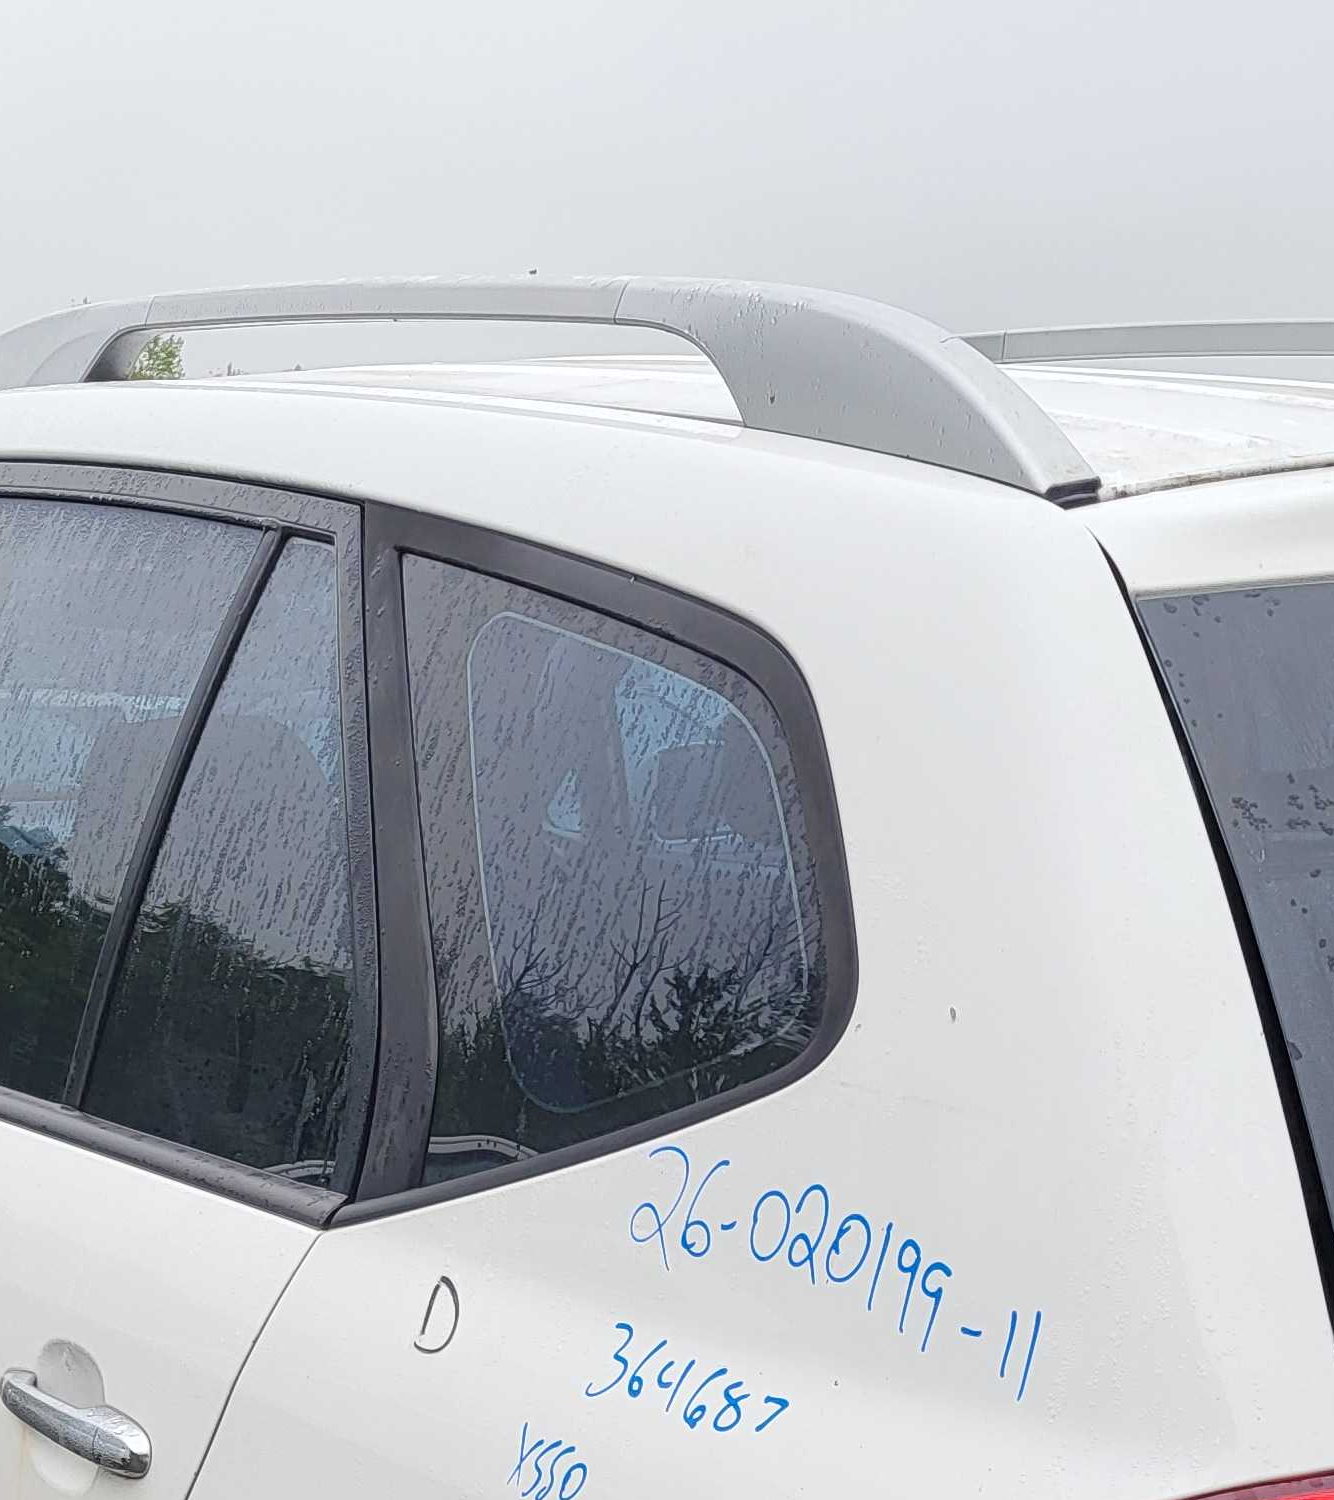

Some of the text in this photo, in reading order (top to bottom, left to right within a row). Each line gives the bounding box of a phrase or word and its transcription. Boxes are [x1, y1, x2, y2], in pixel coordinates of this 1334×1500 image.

[412, 1274, 461, 1355] D
[629, 1145, 1043, 1402] 26-020199-11
[585, 1321, 790, 1433] 364687
